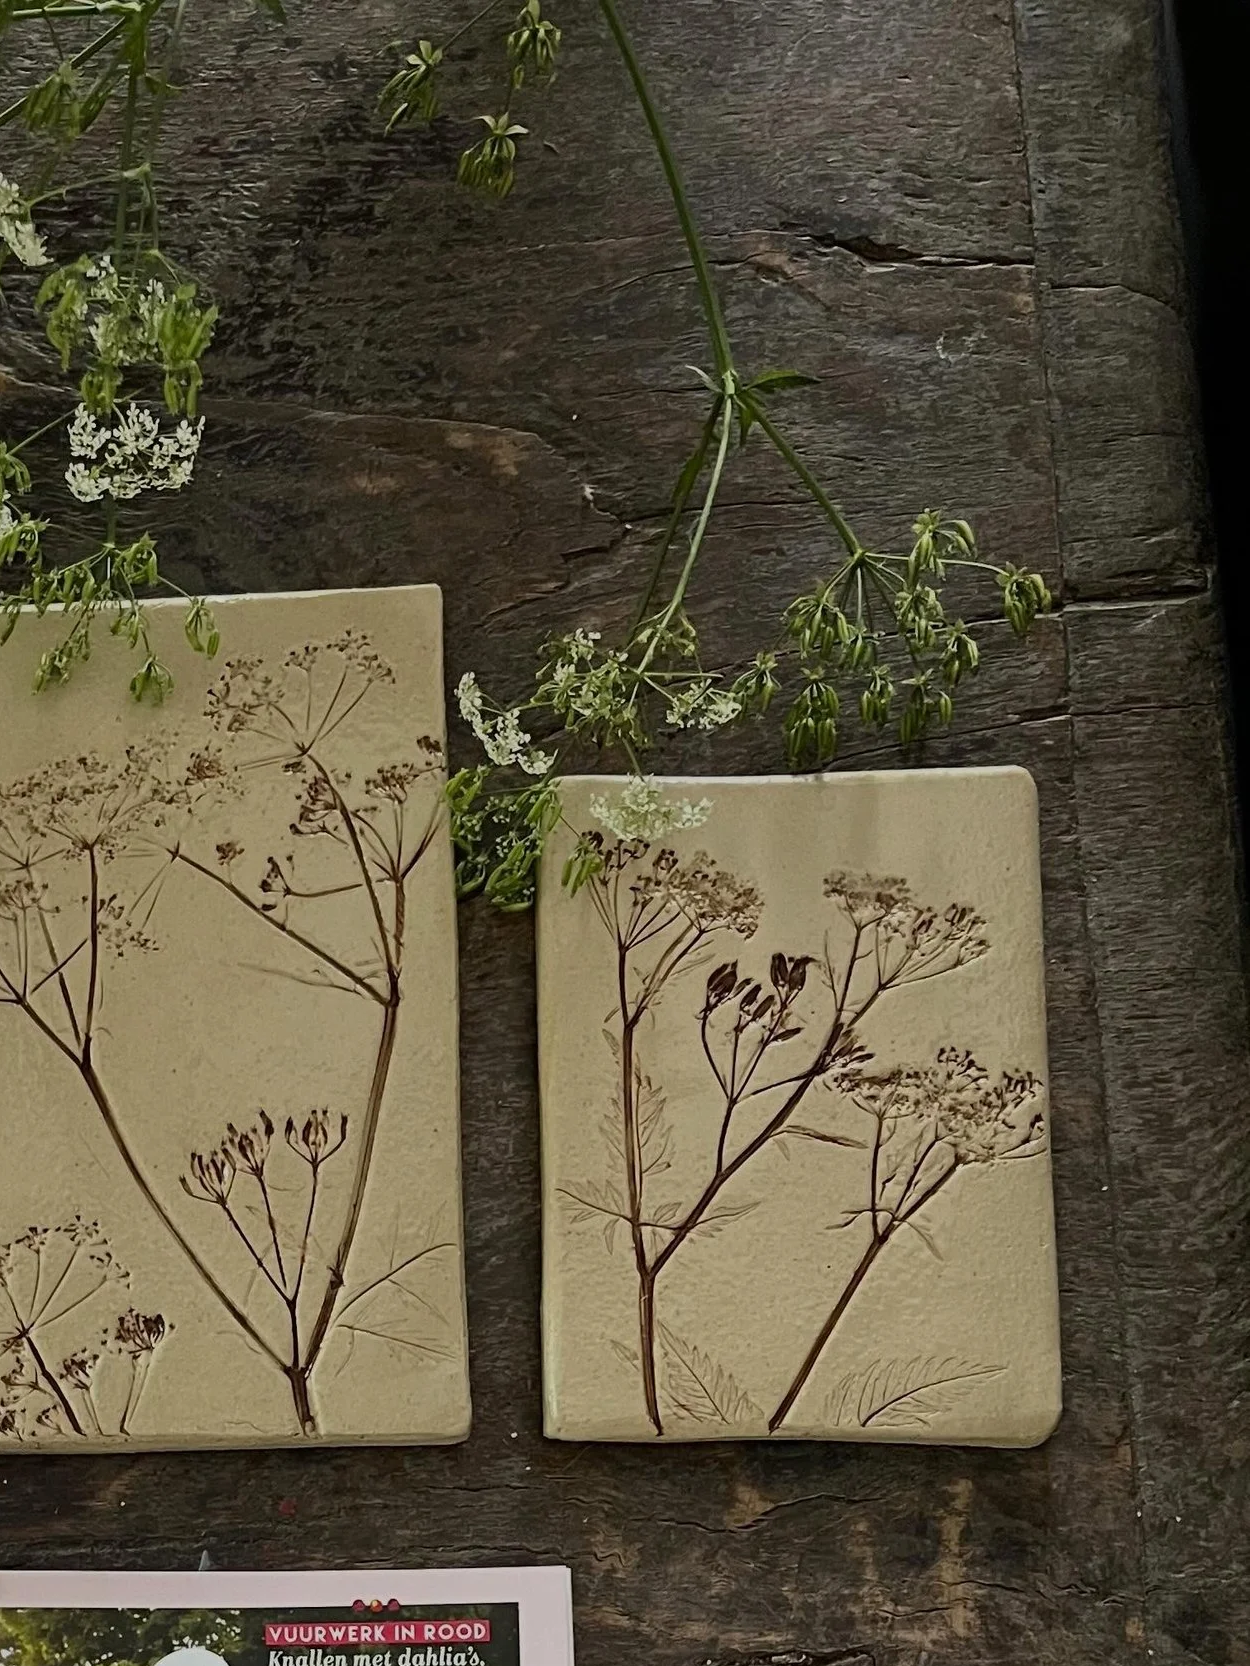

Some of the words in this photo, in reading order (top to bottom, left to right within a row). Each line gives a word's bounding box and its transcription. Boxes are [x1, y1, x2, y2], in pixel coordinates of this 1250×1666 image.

[269, 1623, 386, 1642] VUURWERK
[395, 1623, 415, 1639] IN
[424, 1621, 487, 1639] ROOD
[353, 1650, 392, 1666] met
